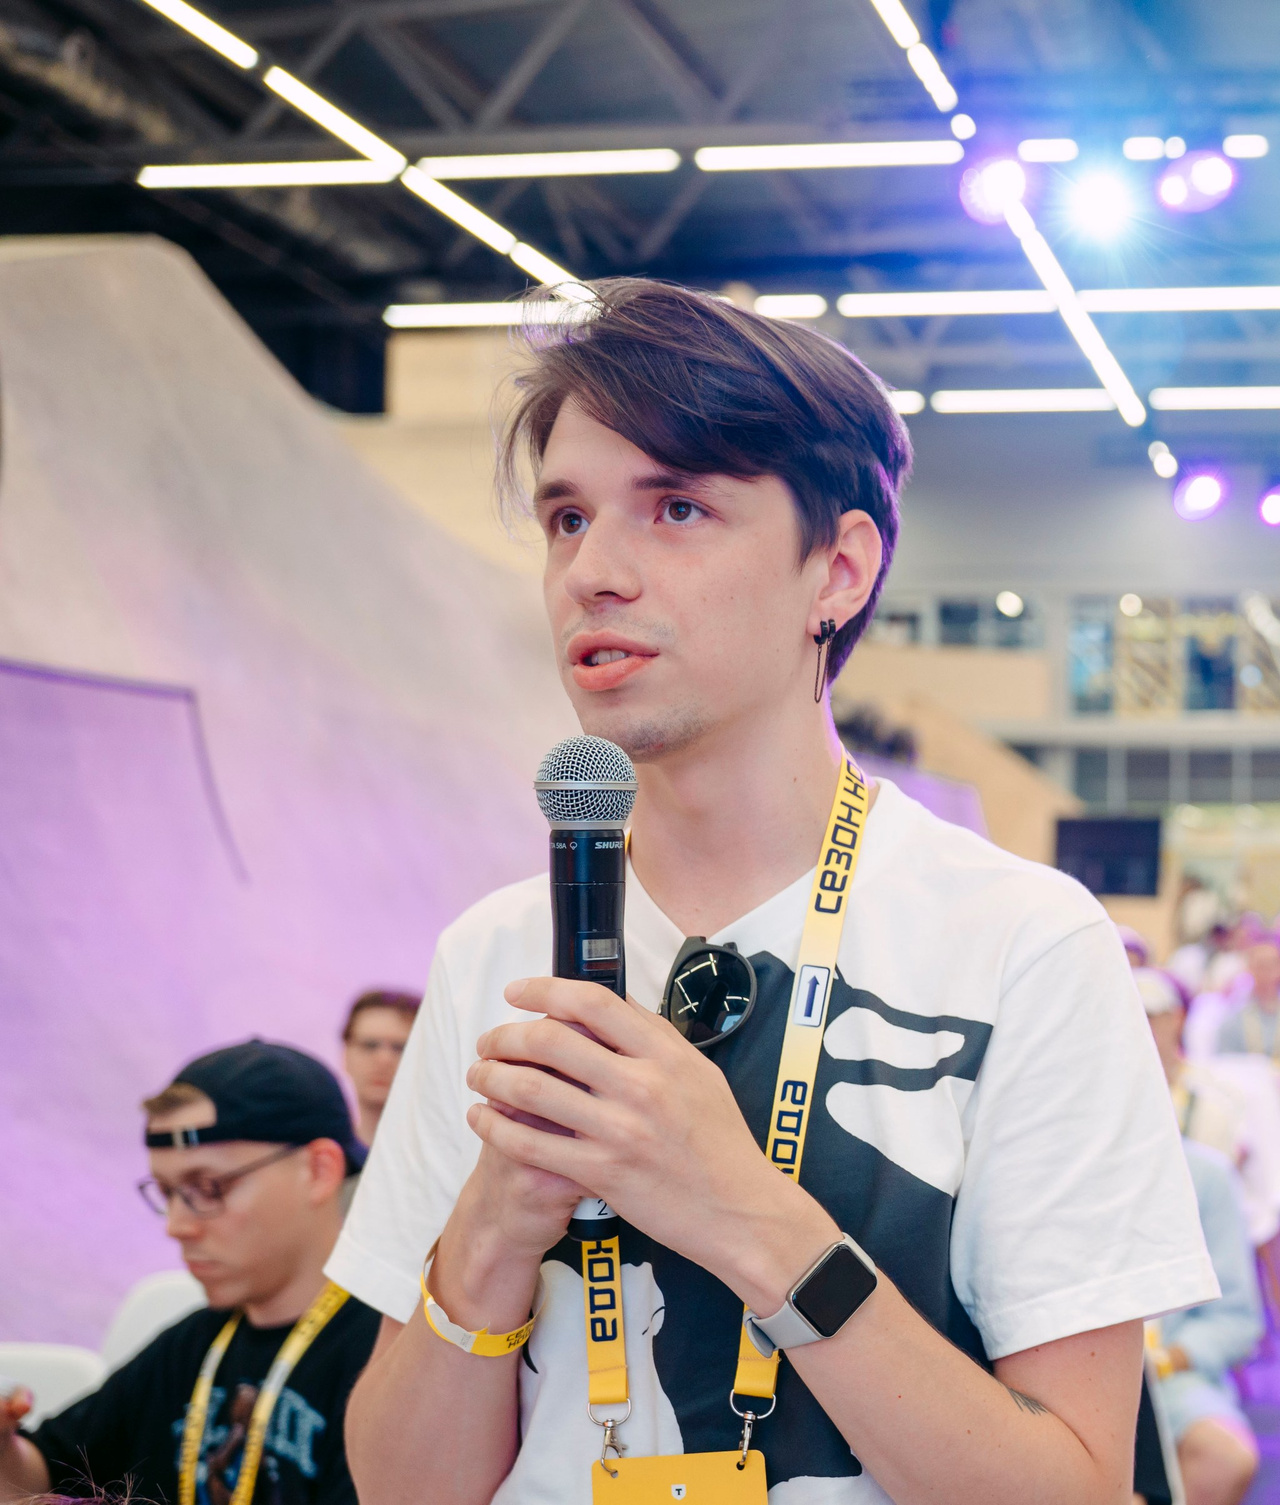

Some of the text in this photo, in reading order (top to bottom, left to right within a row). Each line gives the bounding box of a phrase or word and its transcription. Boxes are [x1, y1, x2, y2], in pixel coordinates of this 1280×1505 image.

[594, 840, 625, 850] SHURE
[597, 1198, 608, 1216] 2
[675, 1488, 683, 1496] T
